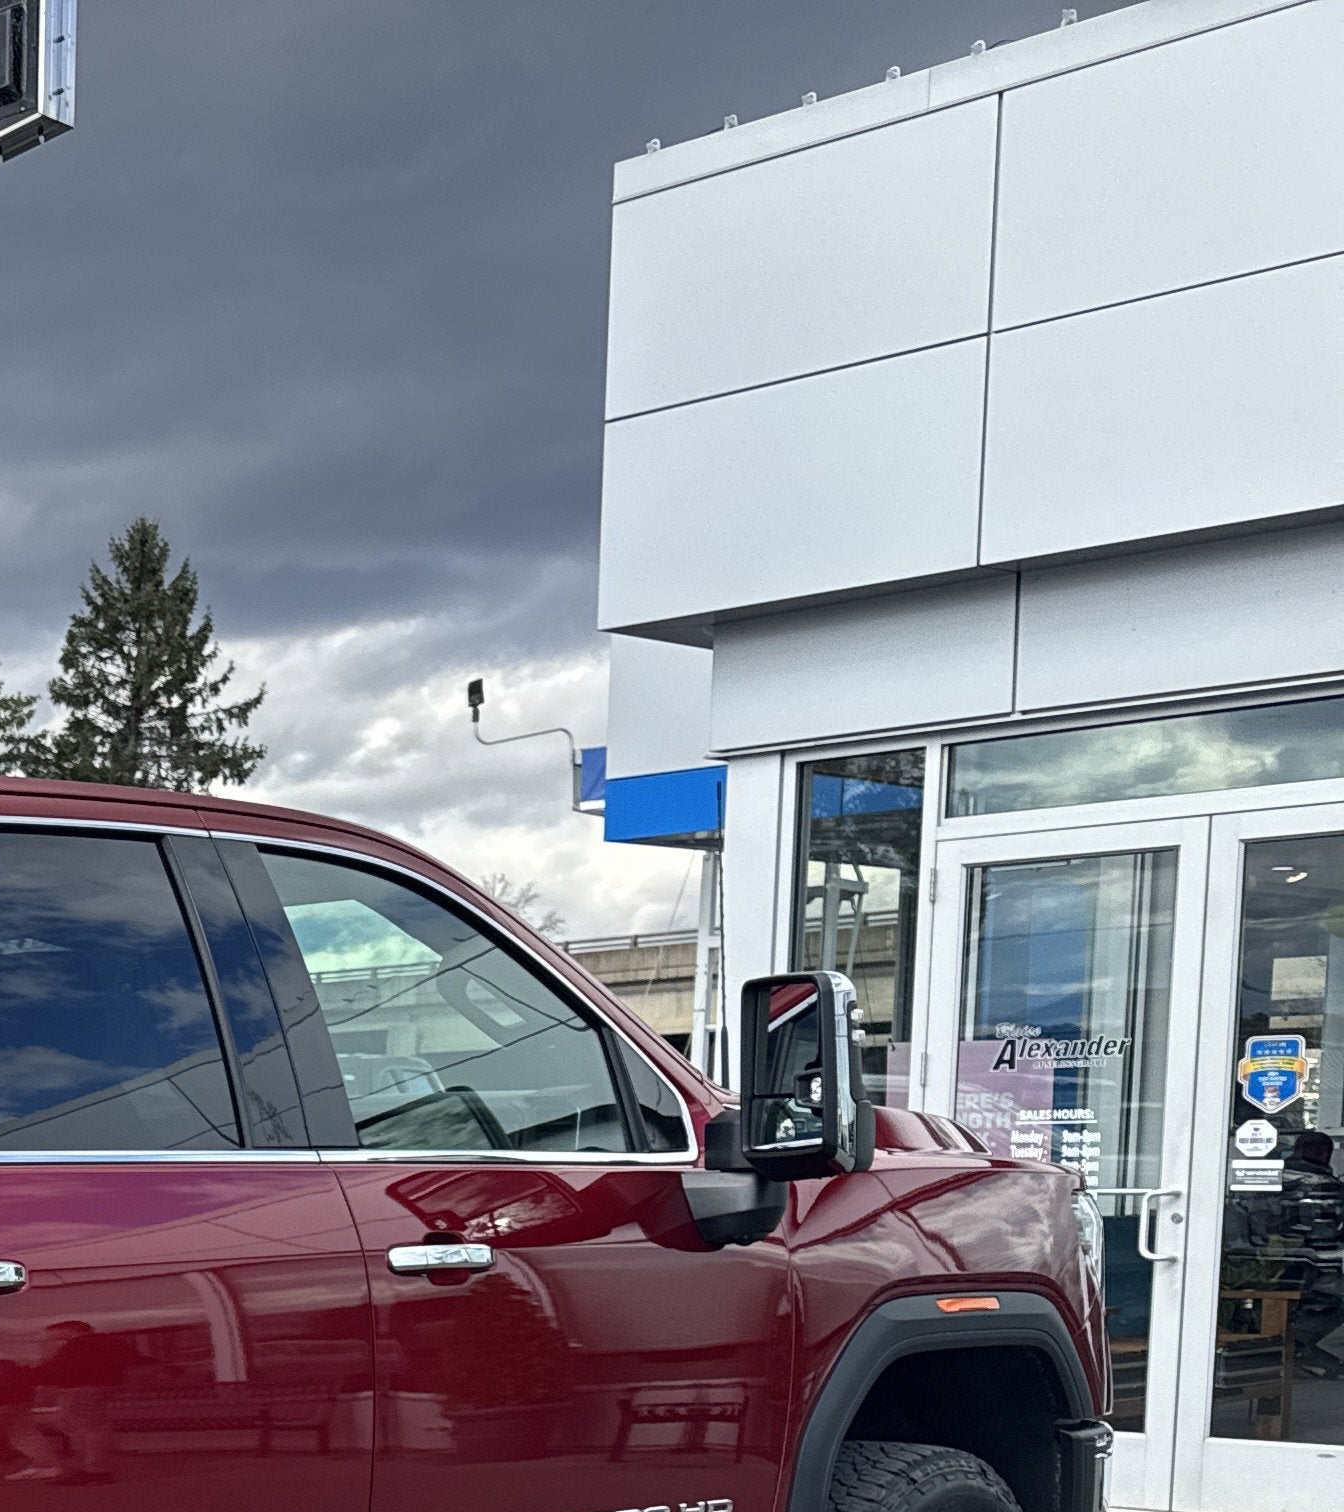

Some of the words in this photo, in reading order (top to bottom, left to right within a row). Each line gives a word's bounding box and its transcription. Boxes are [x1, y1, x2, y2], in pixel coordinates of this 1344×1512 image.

[991, 1035, 1132, 1072] Alexander
[957, 1092, 1015, 1109] ERE'S
[1019, 1109, 1052, 1120] SALES
[1053, 1108, 1095, 1120] HOURS:
